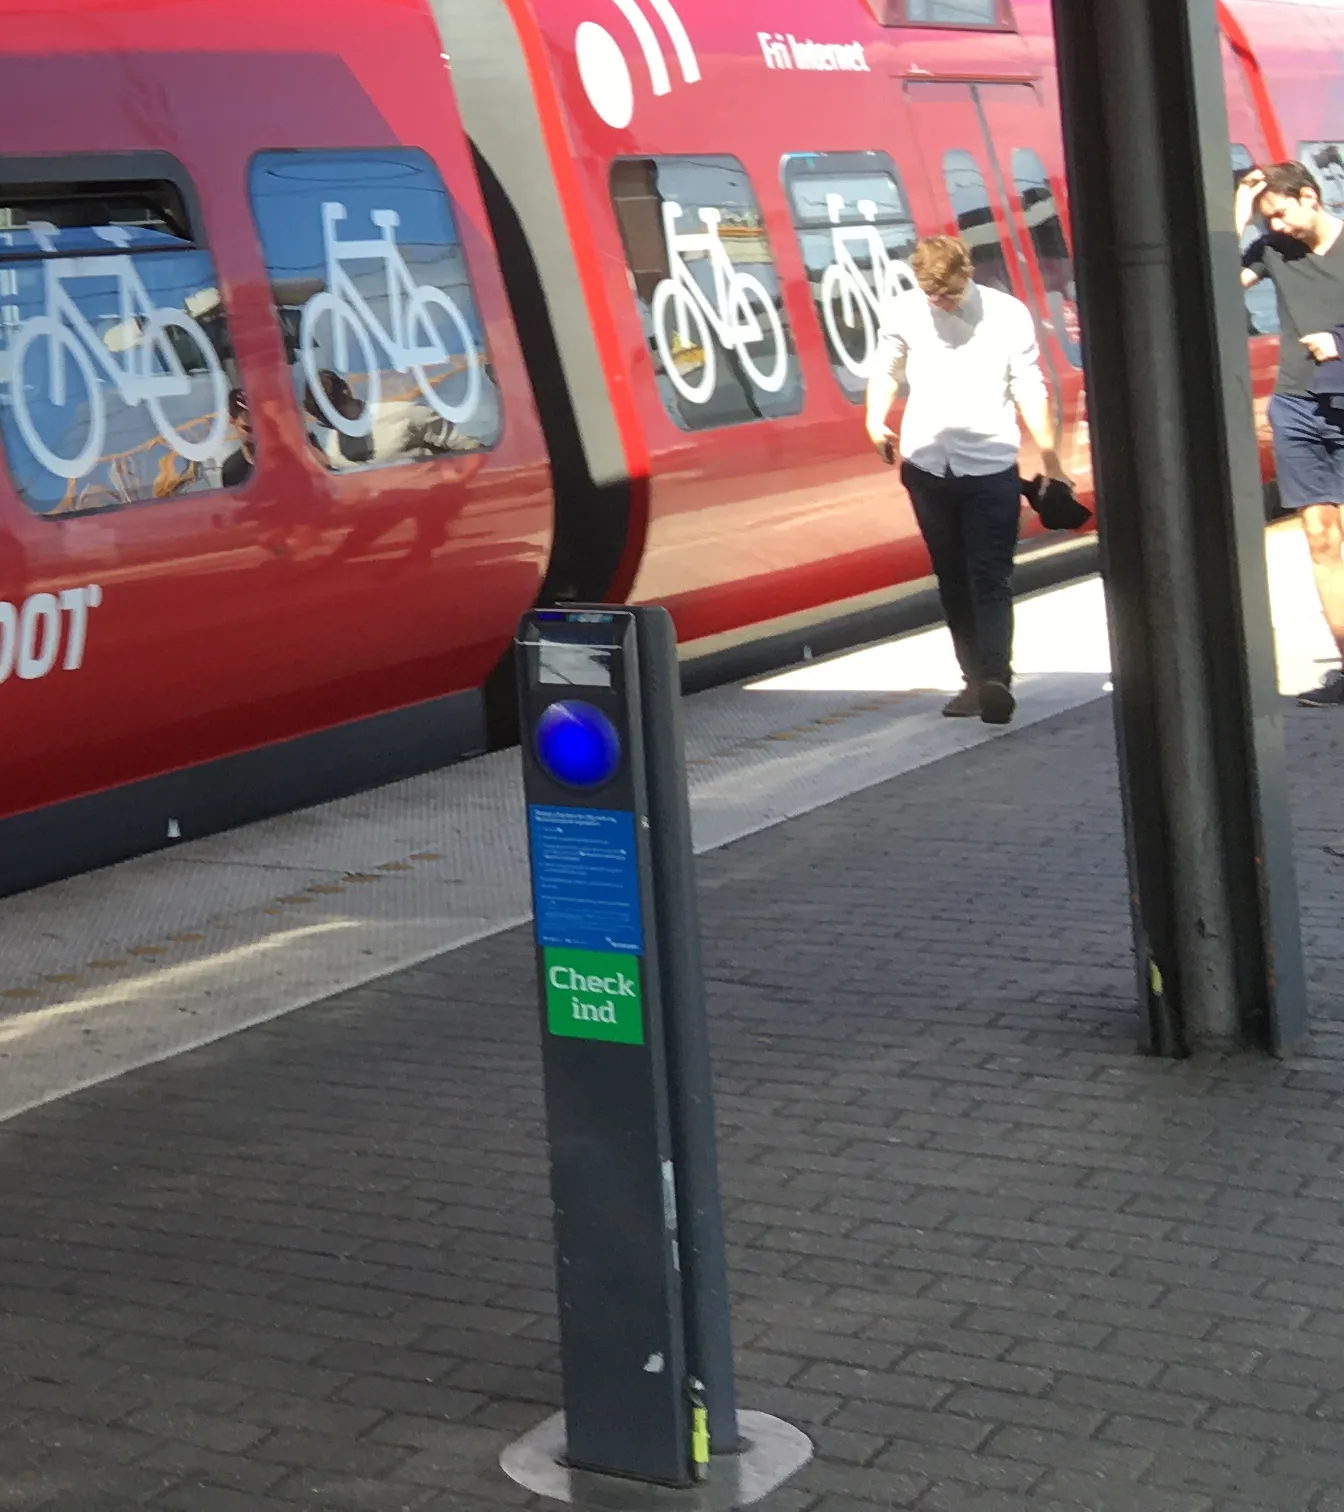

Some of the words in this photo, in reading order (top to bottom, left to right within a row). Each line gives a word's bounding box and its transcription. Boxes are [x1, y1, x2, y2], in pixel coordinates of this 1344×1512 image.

[756, 31, 793, 70] Fri
[549, 965, 637, 998] Check
[571, 996, 619, 1025] ind
